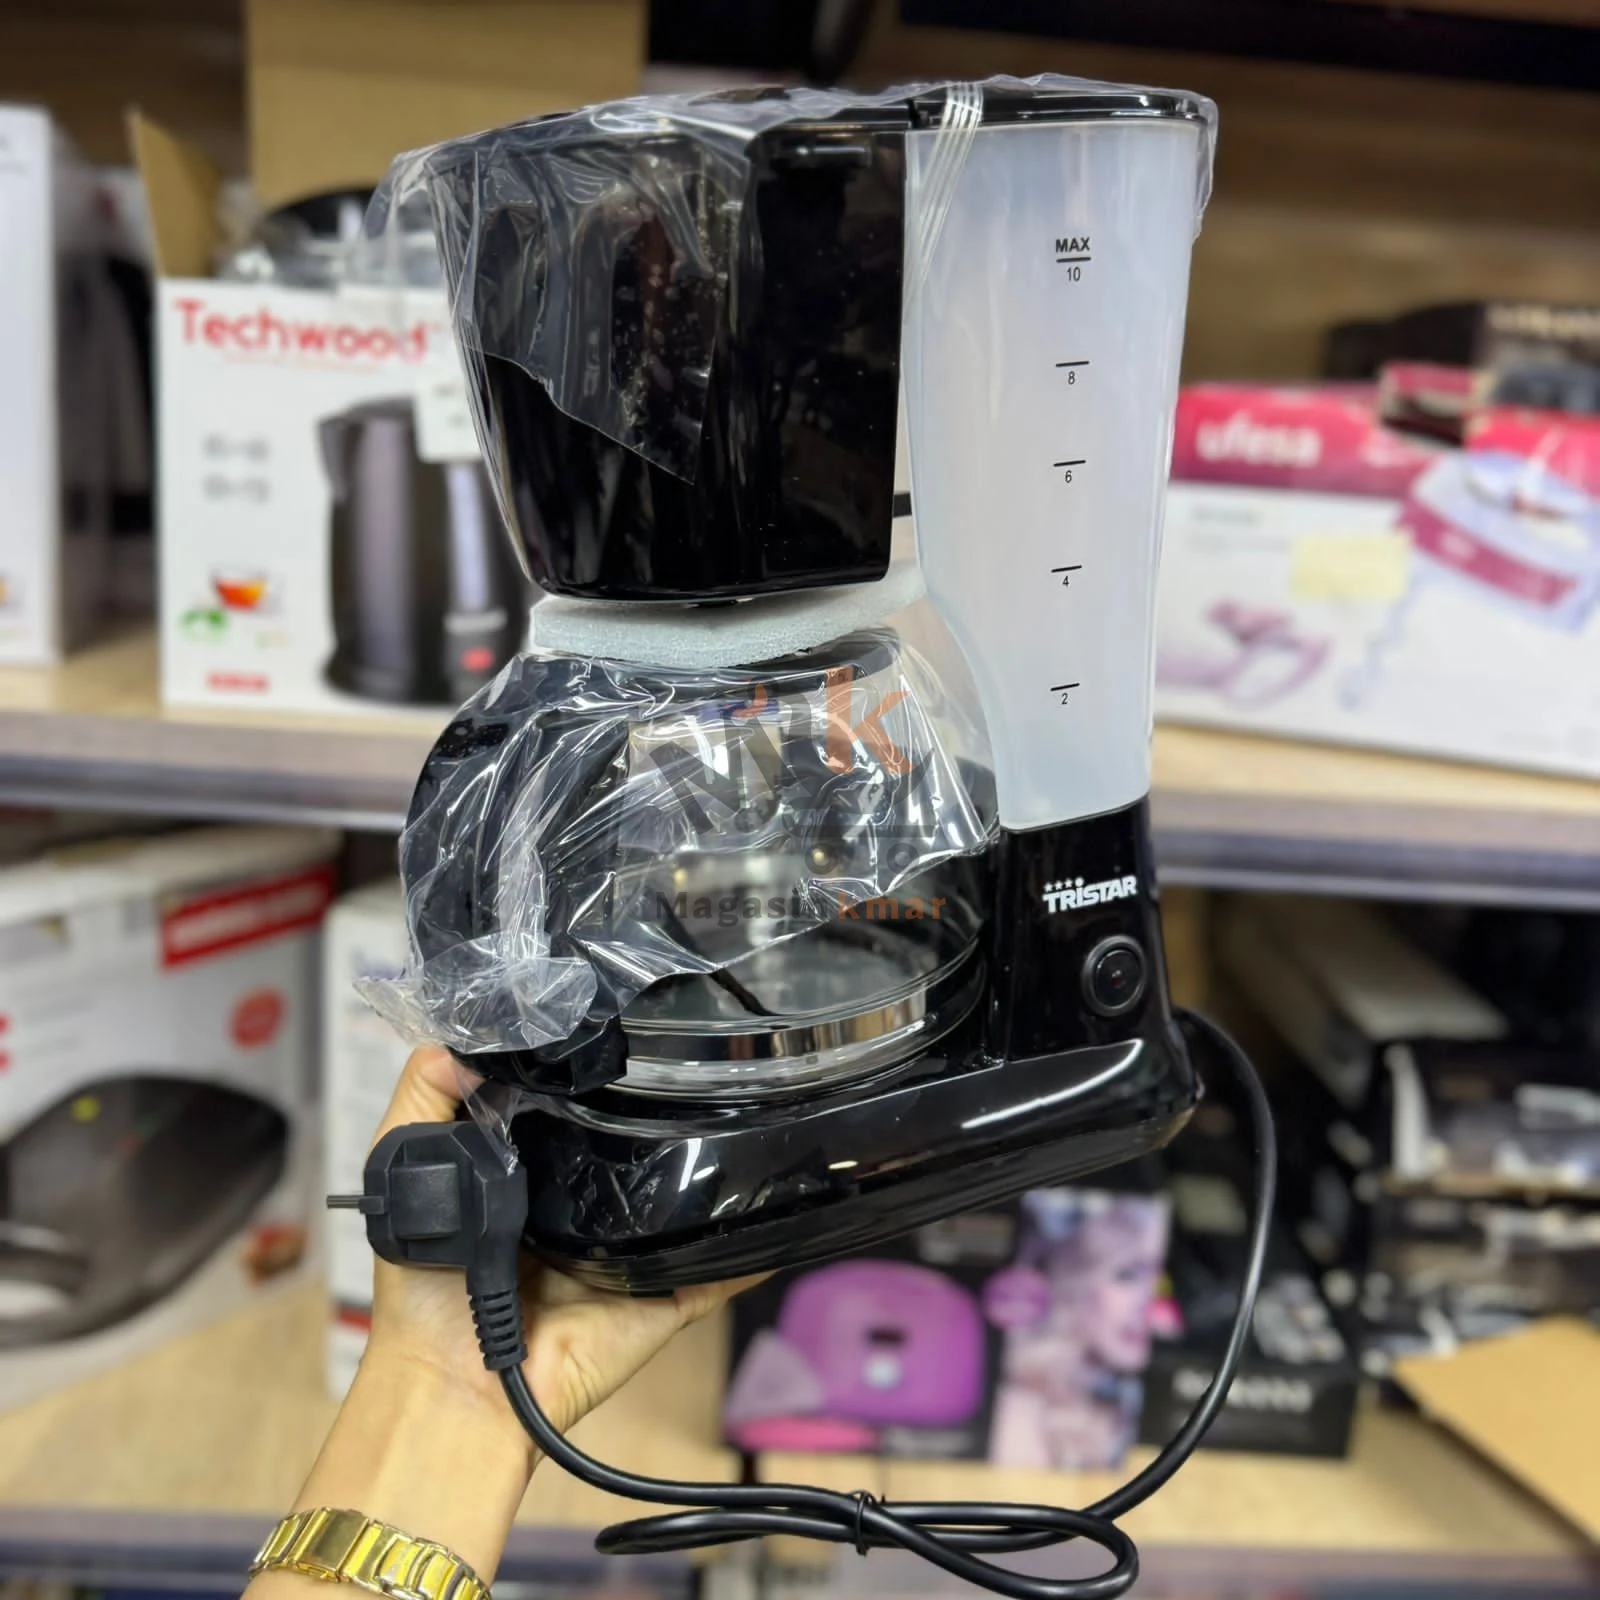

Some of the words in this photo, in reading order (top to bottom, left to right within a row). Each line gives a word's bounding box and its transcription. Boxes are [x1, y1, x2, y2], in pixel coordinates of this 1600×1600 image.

[1055, 237, 1090, 252] MAX
[1066, 266, 1081, 282] 10
[175, 299, 426, 363] Techwood
[1067, 370, 1076, 385] 8
[1064, 469, 1073, 484] 6
[1061, 575, 1070, 588] 4
[1061, 692, 1069, 705] 2
